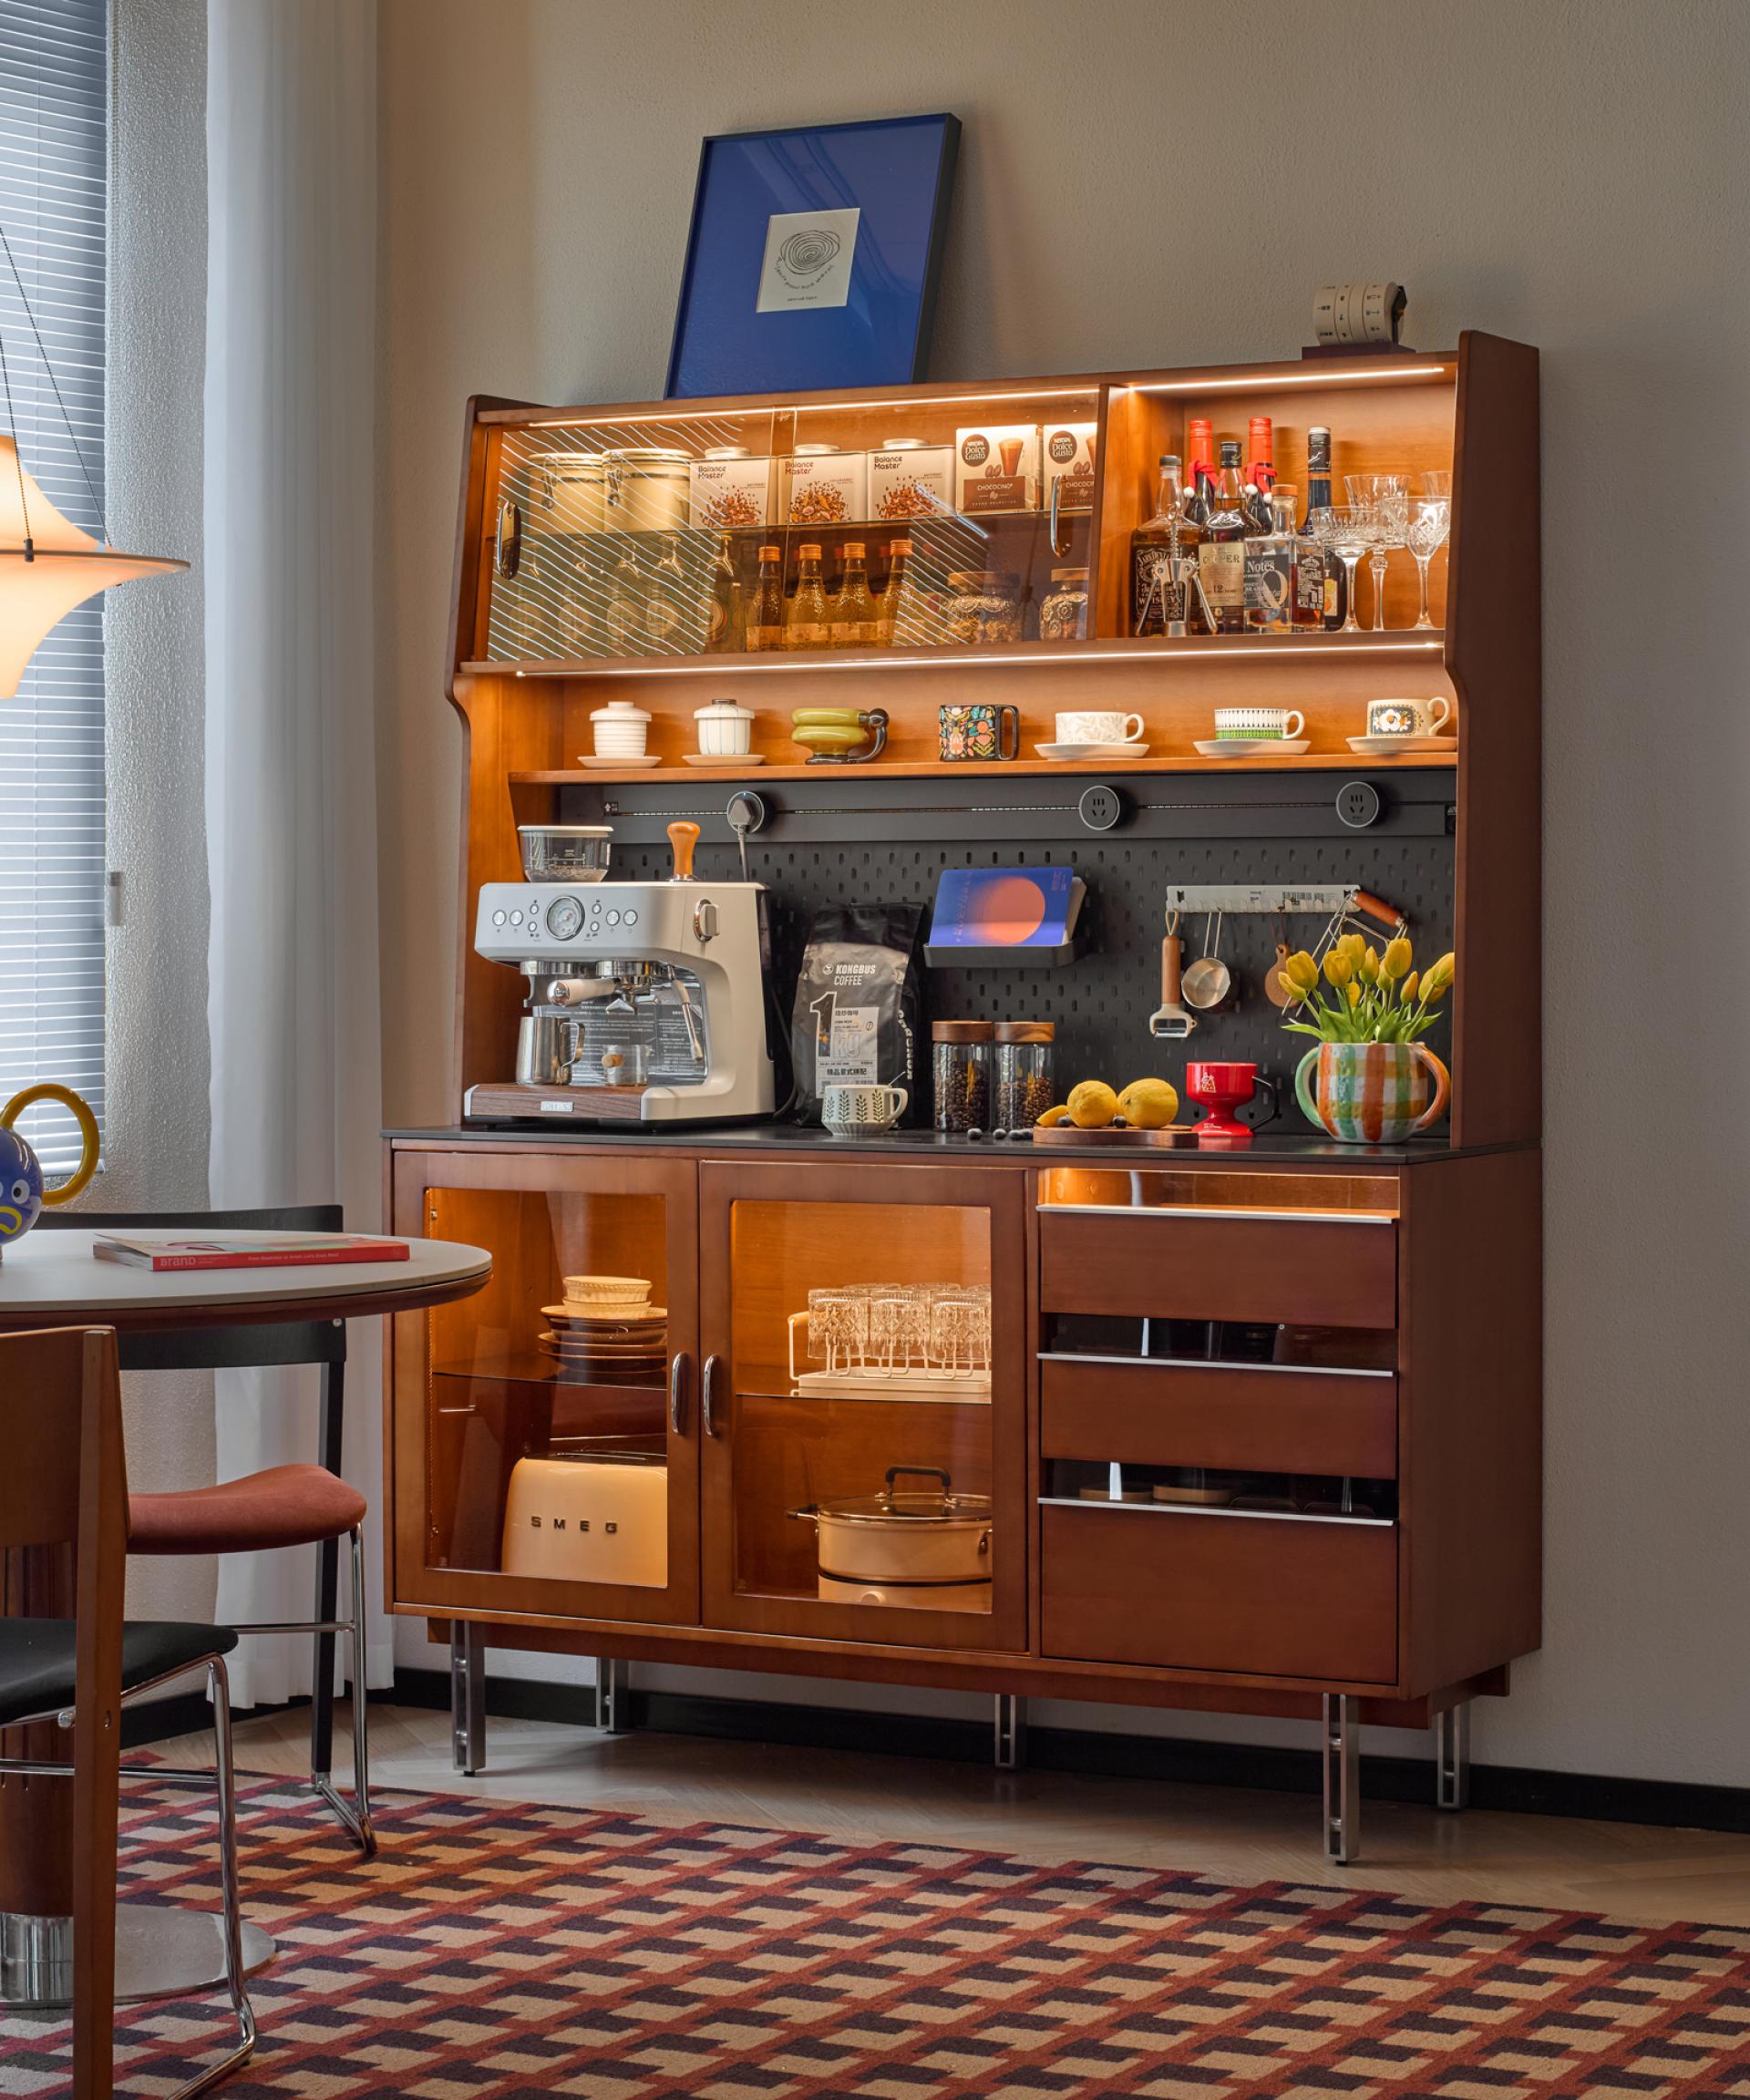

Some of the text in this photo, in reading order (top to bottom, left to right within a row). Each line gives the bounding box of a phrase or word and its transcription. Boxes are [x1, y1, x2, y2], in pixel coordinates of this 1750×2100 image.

[874, 462, 901, 470] Master
[1246, 560, 1275, 573] Notes
[836, 964, 876, 974] KONGBUS
[834, 975, 863, 985] COFFEE
[530, 1515, 618, 1535] SMEG
